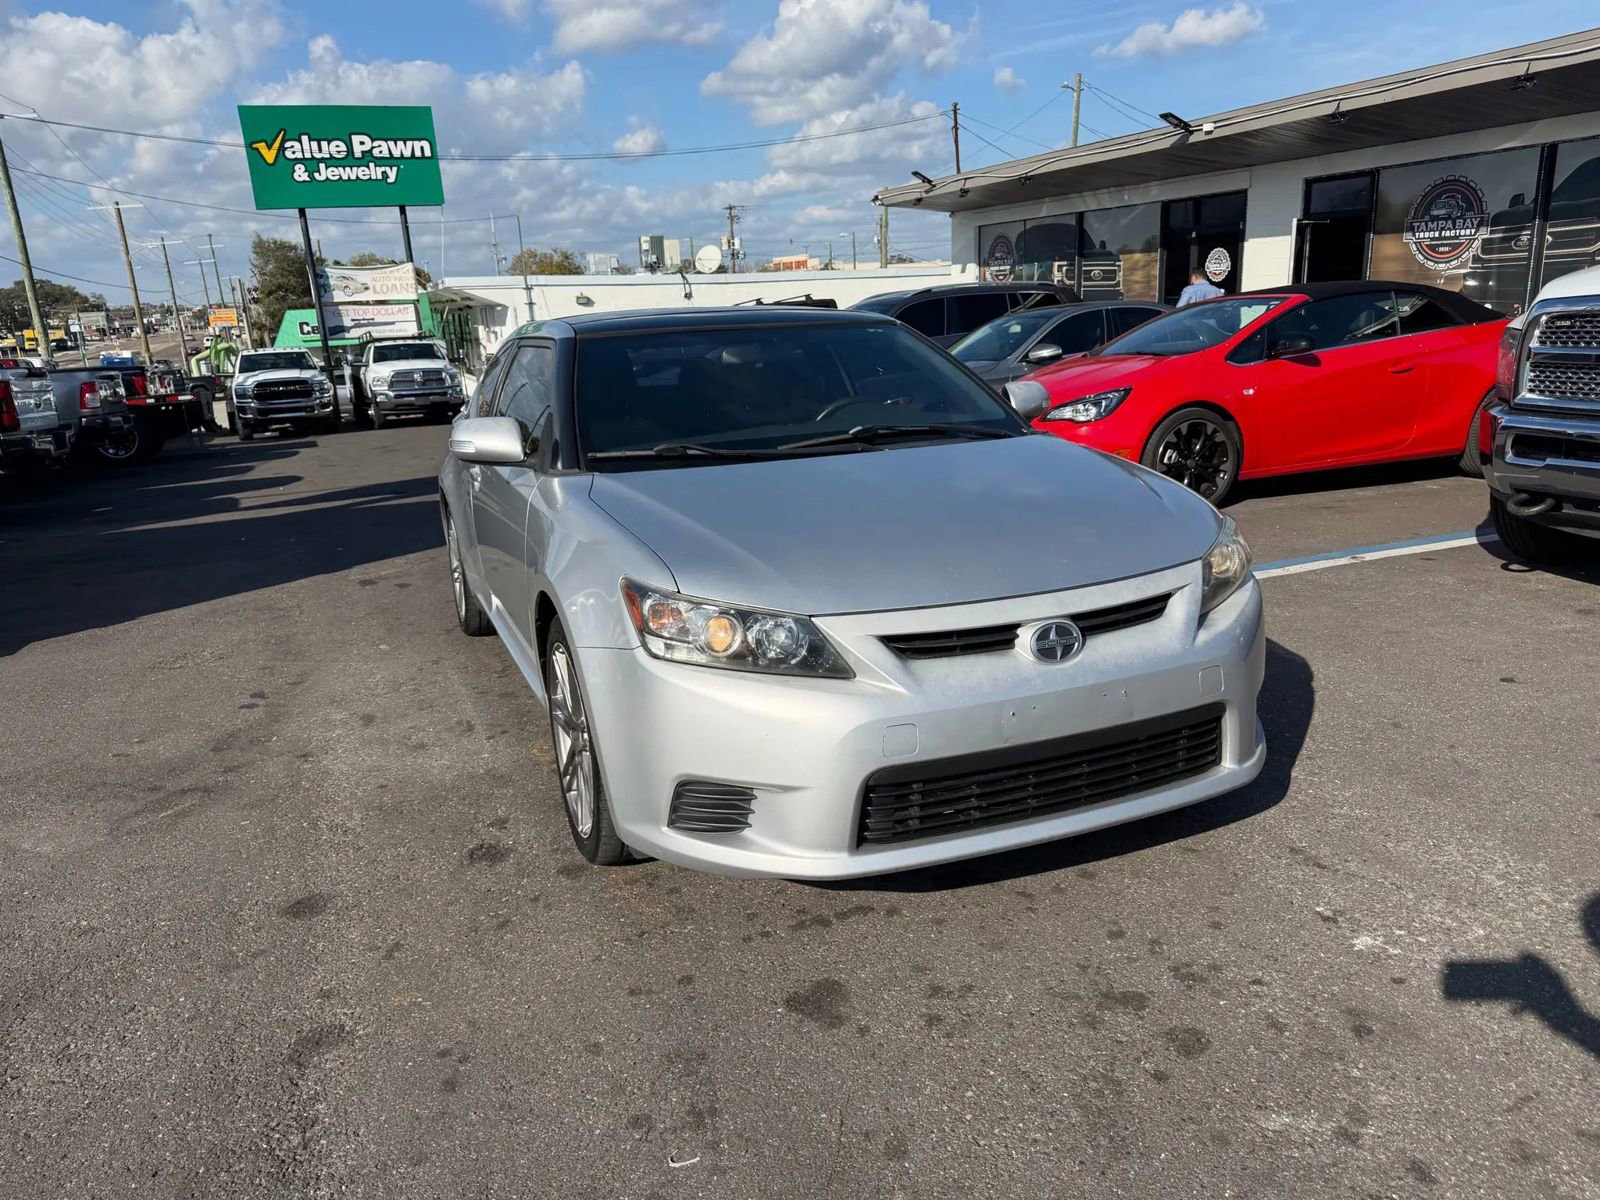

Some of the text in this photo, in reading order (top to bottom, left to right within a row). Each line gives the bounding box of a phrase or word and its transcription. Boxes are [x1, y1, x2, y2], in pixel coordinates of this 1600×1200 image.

[351, 134, 432, 158] Pawn
[293, 162, 398, 183] & Jewelry
[1412, 218, 1480, 231] TAMPA BAY
[1441, 229, 1476, 237] FACTORY
[372, 283, 415, 295] LOANS
[332, 307, 410, 317] GET TOP DOLLAR
